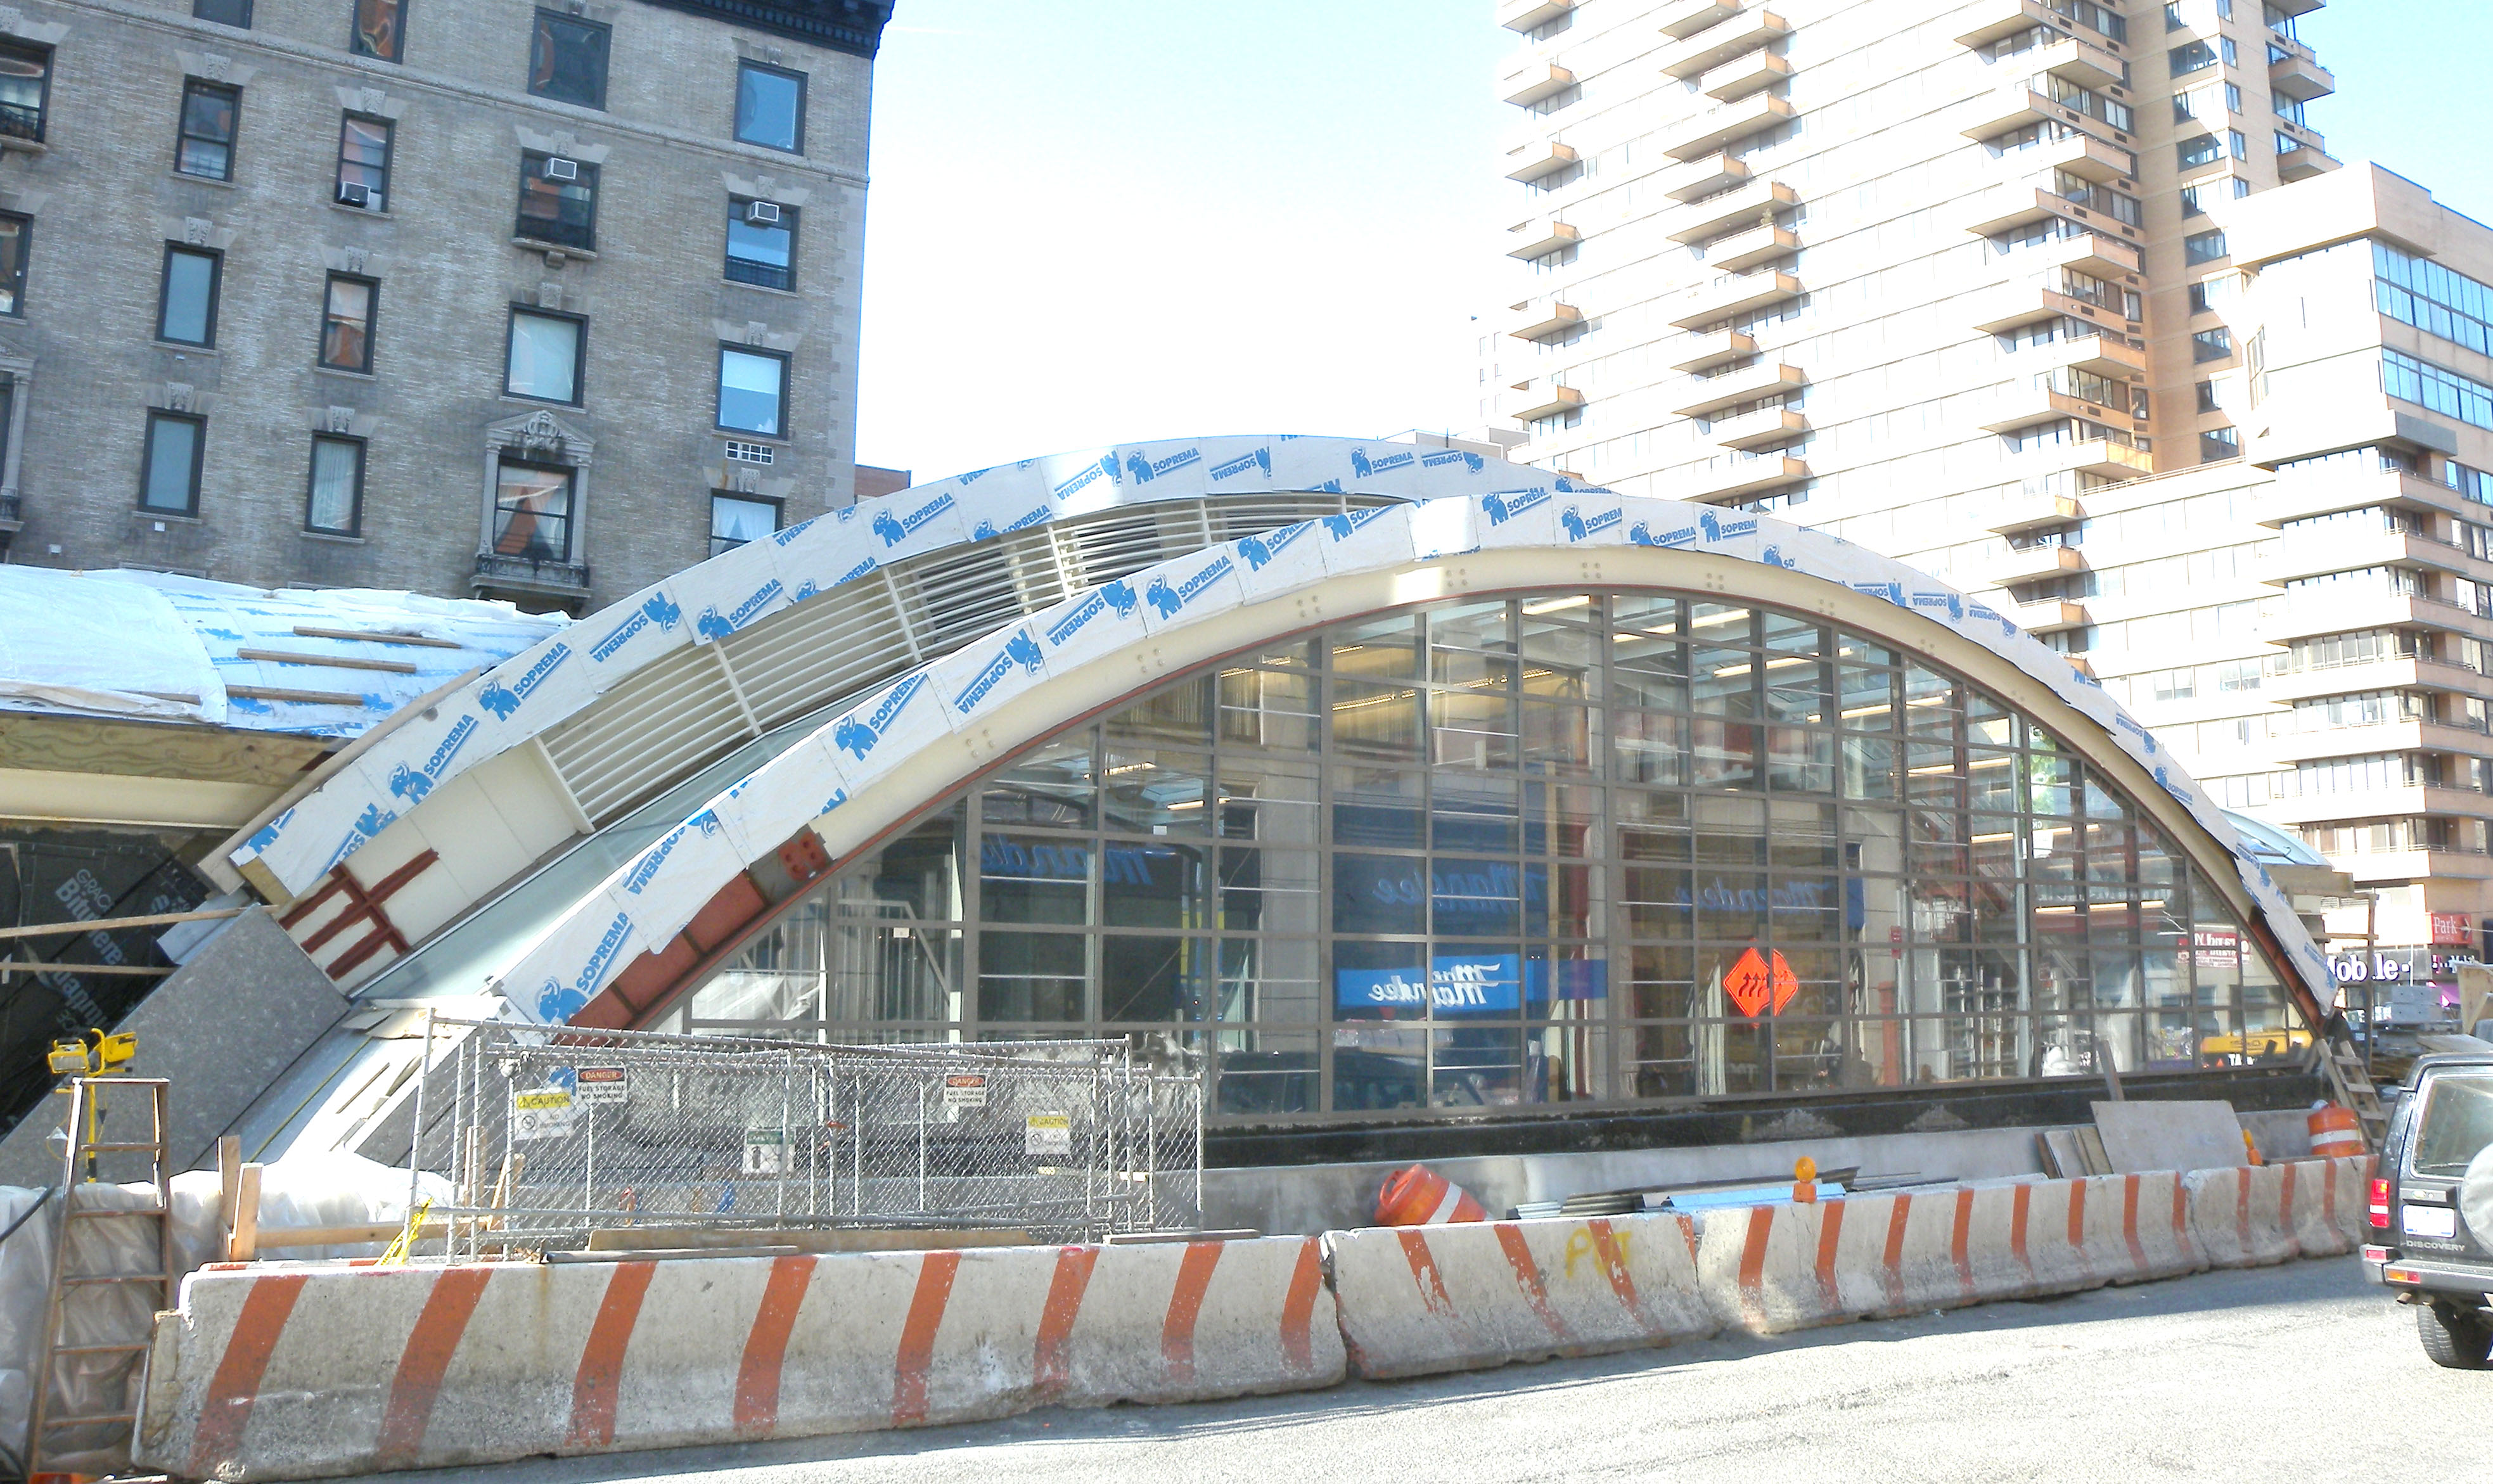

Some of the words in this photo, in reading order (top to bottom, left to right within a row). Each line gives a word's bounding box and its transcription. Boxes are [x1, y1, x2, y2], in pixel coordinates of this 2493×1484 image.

[1153, 447, 1199, 472] SOPREMA
[1211, 457, 1257, 482] SOPREMA
[1371, 452, 1413, 469] SOPREMA
[1423, 452, 1463, 468] SOPREMA
[1056, 466, 1103, 501] SOPREMA
[1507, 487, 1548, 511] SOPREM
[902, 492, 953, 528] SOPREMA
[1586, 508, 1622, 529] SOPREM
[1653, 526, 1696, 545] SOPREMA
[1178, 555, 1231, 598] SOPREMA
[729, 579, 781, 624] SOPREMA
[1913, 597, 1947, 607] SOPREMA
[1049, 598, 1105, 646] SOPREMA
[593, 614, 649, 663] SOPREMA
[513, 642, 568, 695] SOPREMA
[958, 656, 1013, 714] SOPREMA
[423, 714, 474, 776] SOPREMA
[627, 826, 685, 895] OPREMA
[56, 878, 124, 966] Bituene
[2433, 916, 2457, 934] Park
[576, 912, 629, 988] SOPREMA
[2327, 952, 2398, 982] oble
[531, 1096, 570, 1105] CAUTION
[2406, 1240, 2465, 1251] DISCOVERY
